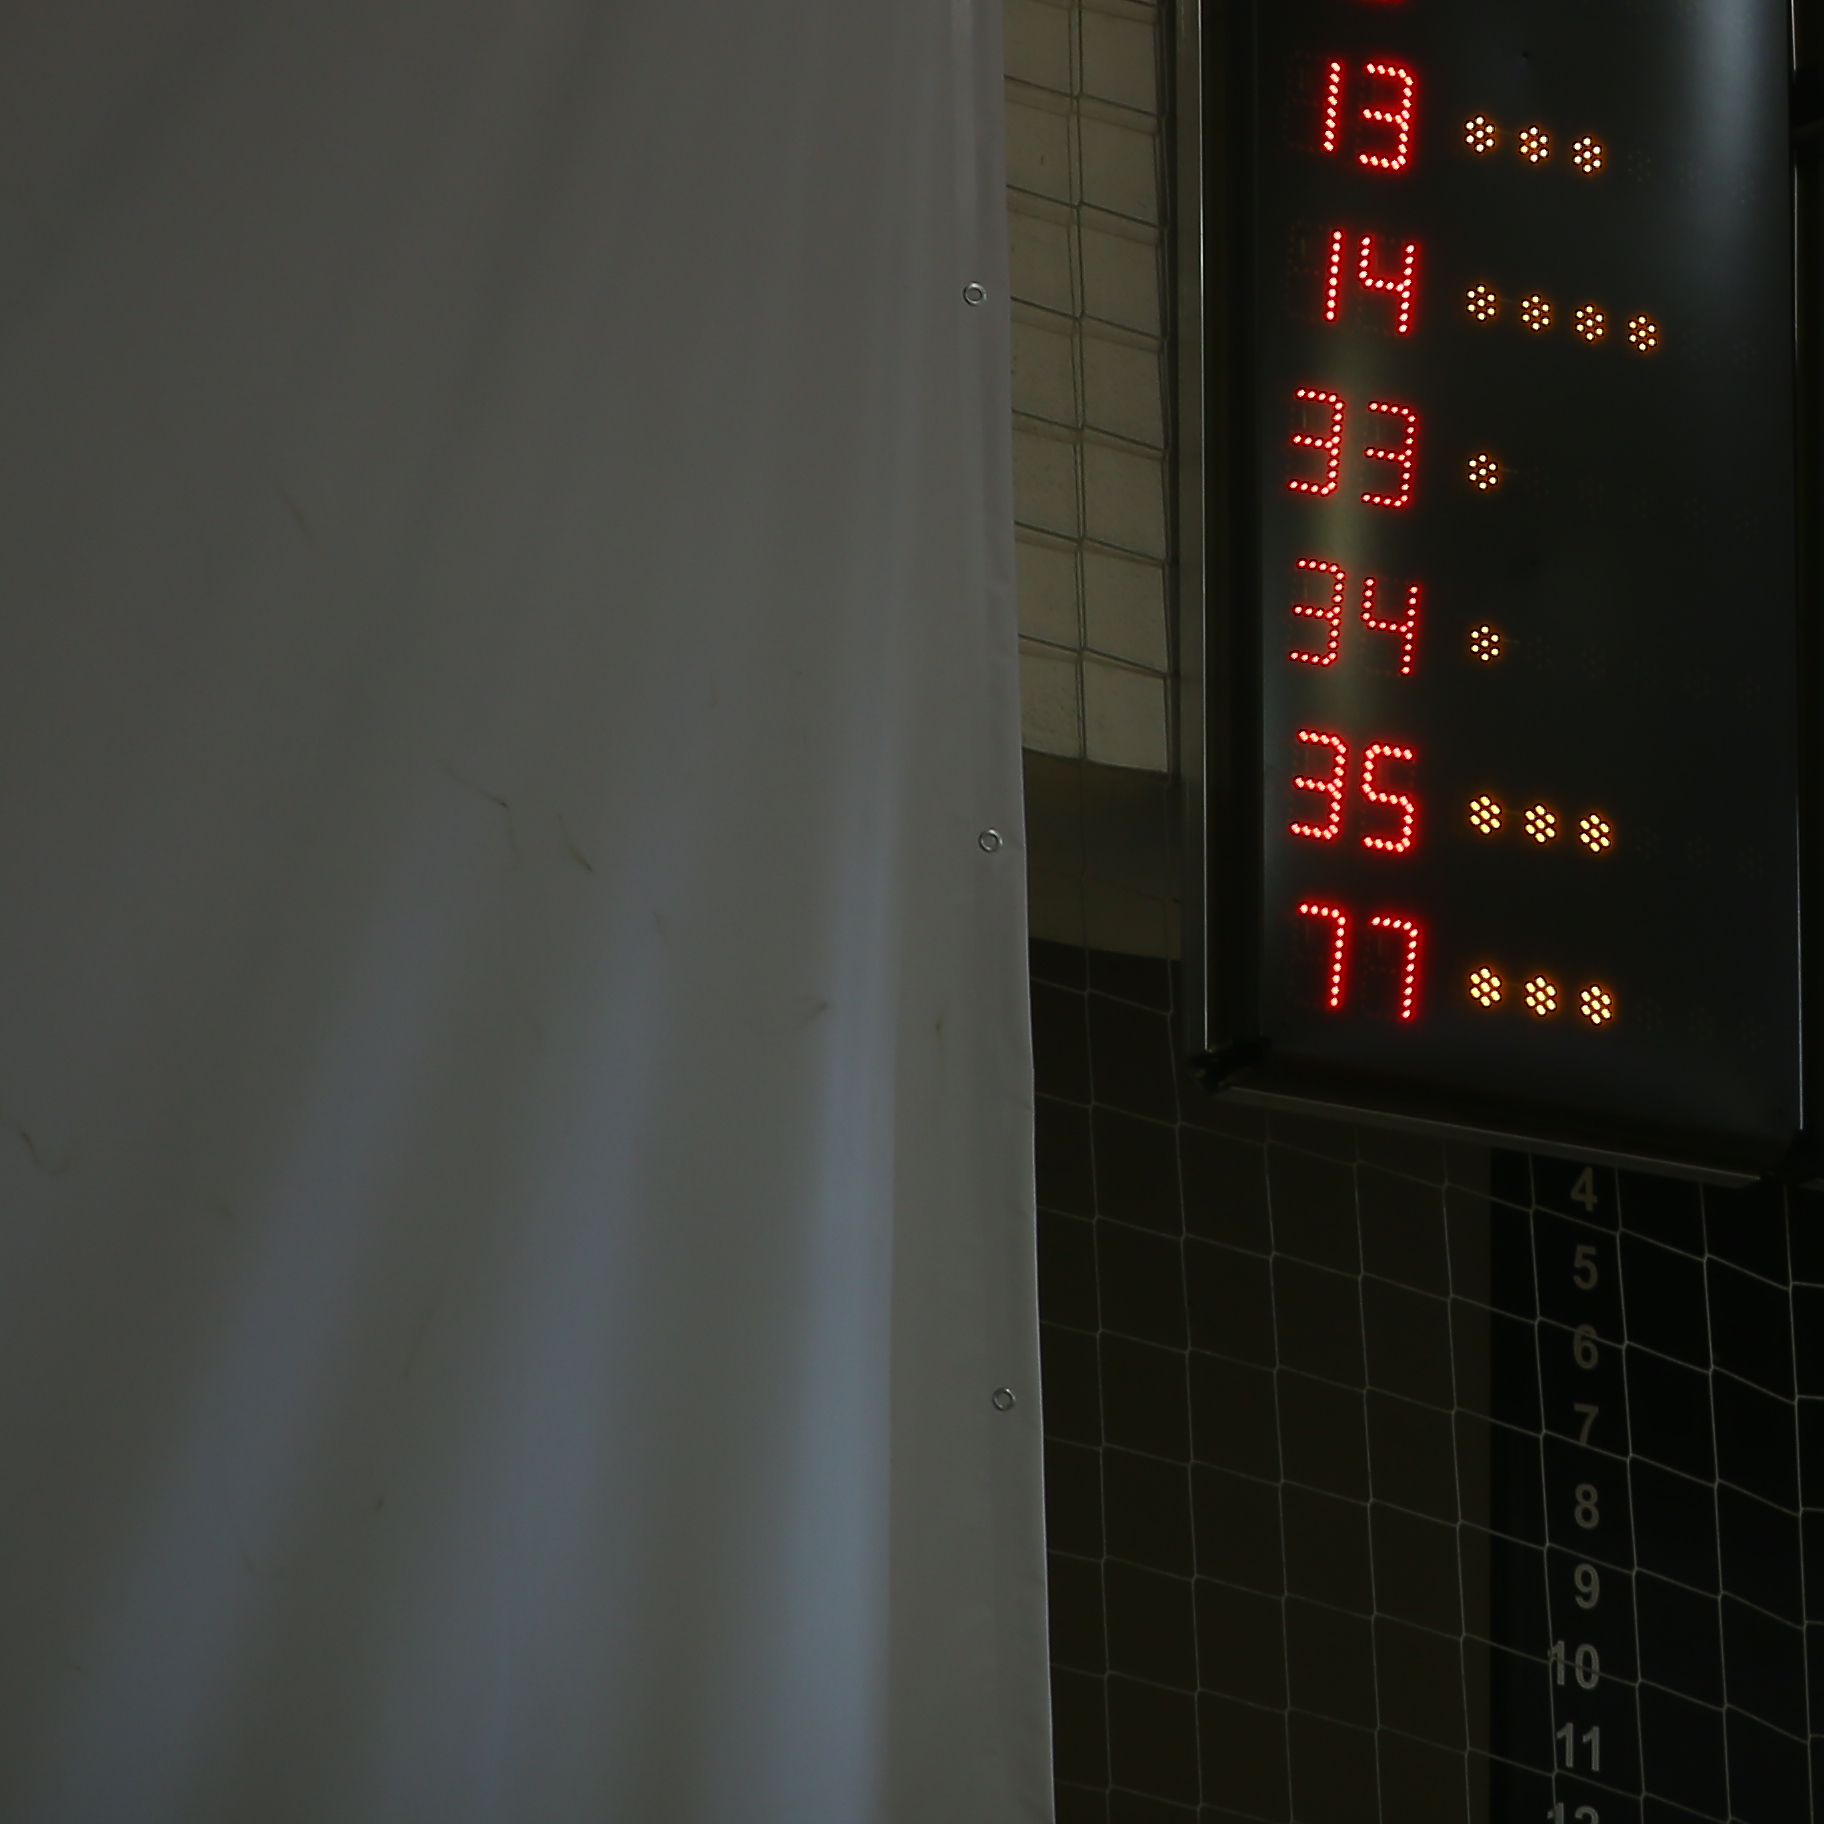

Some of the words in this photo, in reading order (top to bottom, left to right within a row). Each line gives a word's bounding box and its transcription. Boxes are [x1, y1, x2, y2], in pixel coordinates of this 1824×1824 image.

[1320, 59, 1418, 172] 13
[1322, 228, 1420, 335] 14
[1286, 386, 1418, 509] 33
[1288, 557, 1420, 676] 34
[1287, 728, 1420, 855] 35
[1296, 899, 1423, 1021] 77
[1570, 1166, 1598, 1212] 4
[1572, 1244, 1599, 1291] 5
[1572, 1324, 1599, 1370] 6
[1572, 1402, 1600, 1447] 7
[1573, 1482, 1600, 1530] 8
[1573, 1562, 1600, 1610] 9
[1547, 1639, 1600, 1690] 10
[1556, 1722, 1600, 1772] 11
